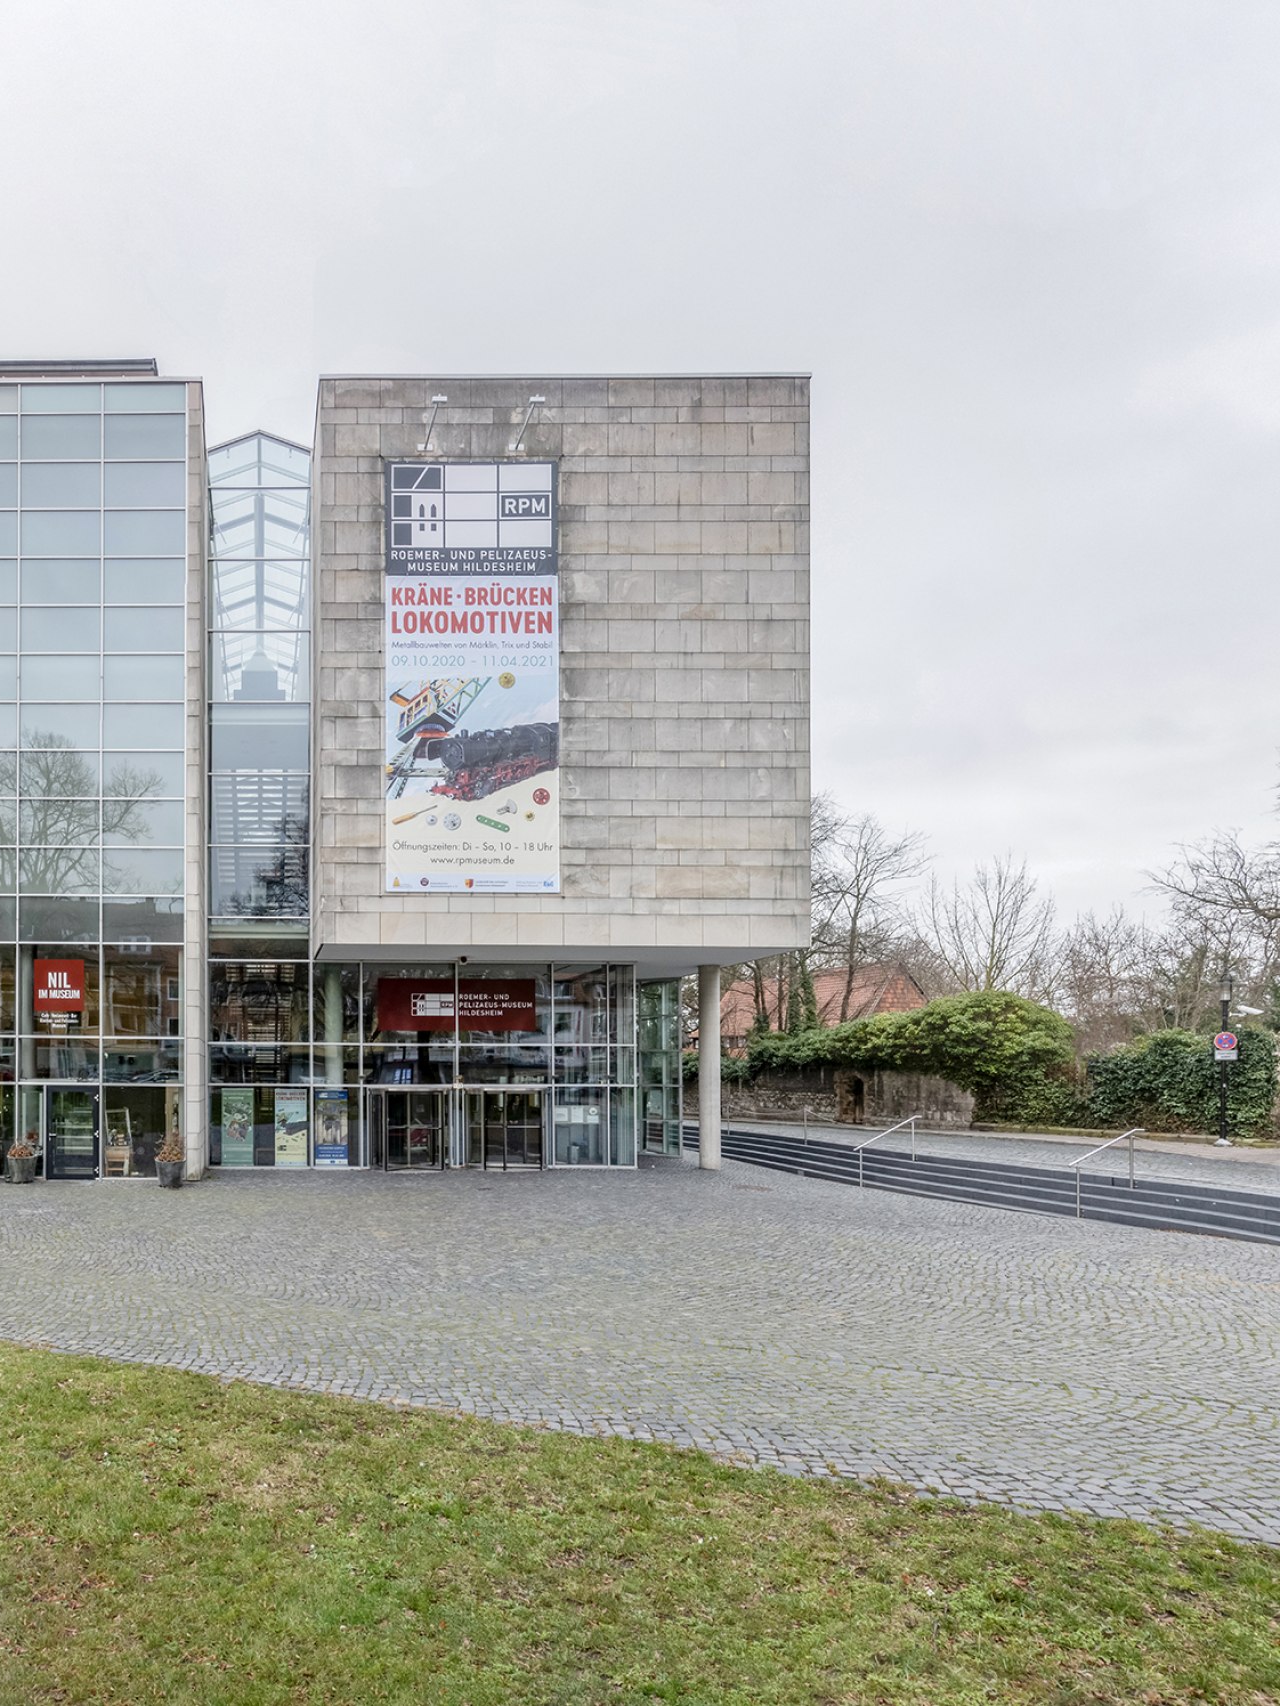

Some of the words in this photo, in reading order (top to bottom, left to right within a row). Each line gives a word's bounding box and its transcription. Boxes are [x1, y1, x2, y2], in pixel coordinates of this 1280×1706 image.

[504, 498, 546, 514] RPM
[390, 550, 445, 561] ROEMER-
[450, 550, 476, 561] UND
[480, 550, 552, 561] PELIZAEUS-
[407, 561, 459, 572] MUSEUM
[463, 561, 536, 572] HILDESHEIM
[391, 582, 453, 606] KRÄNE
[464, 582, 553, 607] BRÜCKEN
[391, 610, 553, 635] LOKOMOTIVEN
[391, 640, 453, 649] Metallbauwelten
[470, 640, 499, 650] Märklin,
[501, 640, 514, 649] Trix
[516, 640, 530, 649] und
[532, 640, 553, 649] Stabil
[391, 655, 466, 667] 09.10.2020
[482, 655, 553, 667] 11.04.2021
[392, 839, 460, 853] Öffnungszeiten:
[462, 841, 472, 851] Di
[500, 842, 512, 851] 10
[523, 842, 535, 851] 18
[536, 841, 553, 851] Uhr
[430, 854, 516, 867] www.rpmuseum.de
[48, 972, 71, 988] NIL
[38, 989, 48, 998] IM
[49, 989, 81, 998] MUSEUM
[458, 1009, 504, 1017] HILDESHEIM
